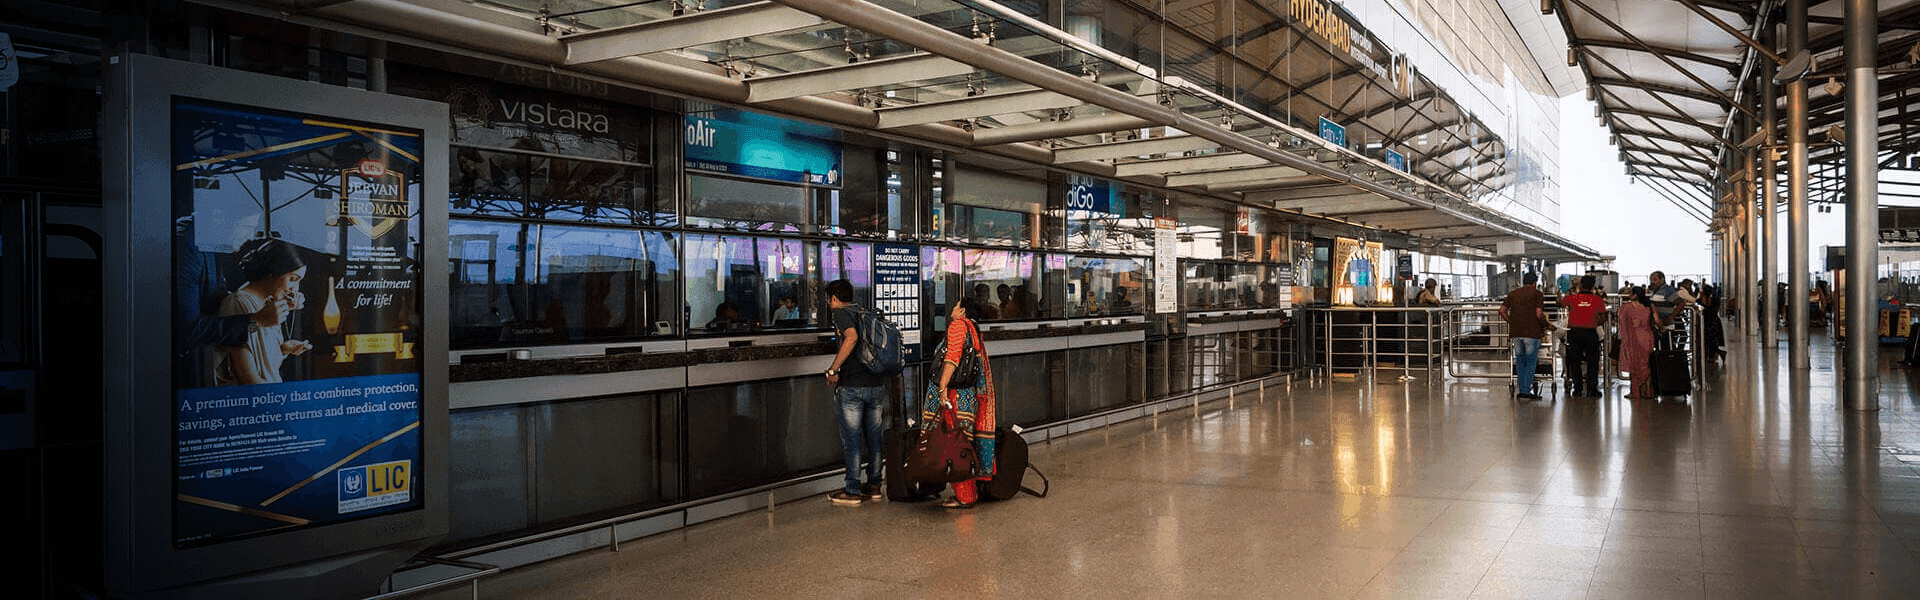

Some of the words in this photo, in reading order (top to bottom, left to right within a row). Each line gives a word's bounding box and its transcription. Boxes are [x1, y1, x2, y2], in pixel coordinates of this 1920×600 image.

[1291, 0, 1351, 53] HYDERABAD
[684, 119, 716, 148] oAir
[347, 182, 399, 196] JEEVAN
[333, 200, 414, 216] SHIROMANI
[875, 254, 902, 262] DANGEROUS
[335, 277, 345, 289] A
[347, 277, 411, 289] commitment
[354, 294, 373, 309] for
[373, 294, 393, 309] life!
[181, 399, 193, 411] A
[196, 396, 249, 412] premium
[252, 392, 287, 408] policy
[290, 390, 312, 402] that
[313, 386, 362, 400] combines
[363, 382, 419, 398] protection,
[179, 417, 226, 431] savings,
[229, 411, 282, 427] attractive
[284, 407, 323, 421] returns
[324, 404, 344, 417] and
[346, 401, 387, 414] medical
[388, 401, 418, 411] cover.
[371, 464, 405, 494] LIC
